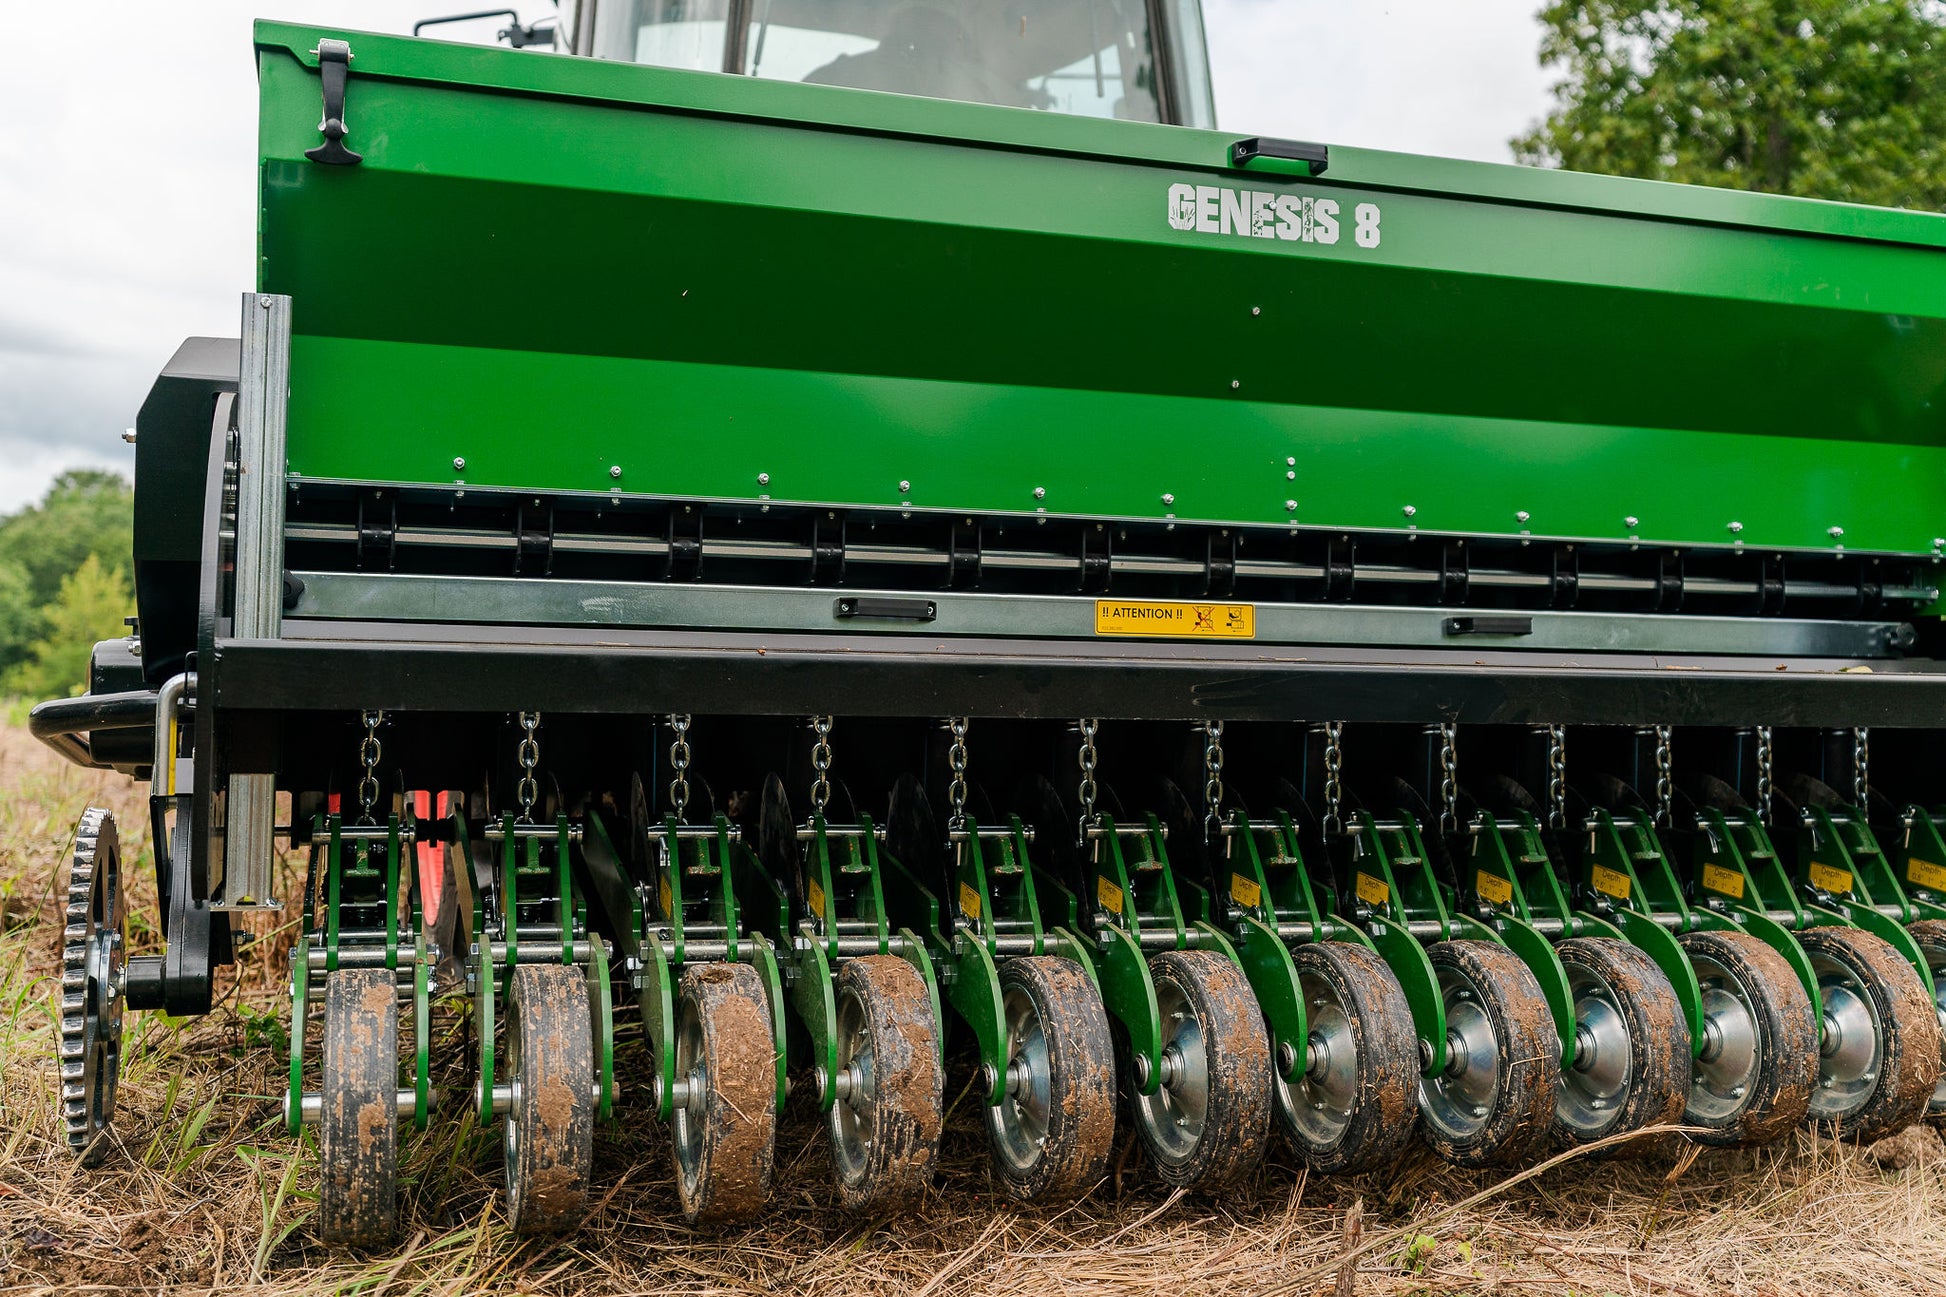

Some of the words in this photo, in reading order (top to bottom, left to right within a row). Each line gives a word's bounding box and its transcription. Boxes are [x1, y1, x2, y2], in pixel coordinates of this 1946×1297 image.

[1168, 183, 1340, 245] GENESIS
[1355, 202, 1381, 249] 8
[1112, 608, 1173, 619] ATTENTION
[1714, 867, 1734, 881] Depth
[1821, 866, 1842, 880] Depth
[1920, 862, 1942, 876] Depth
[1602, 869, 1621, 884] Depth
